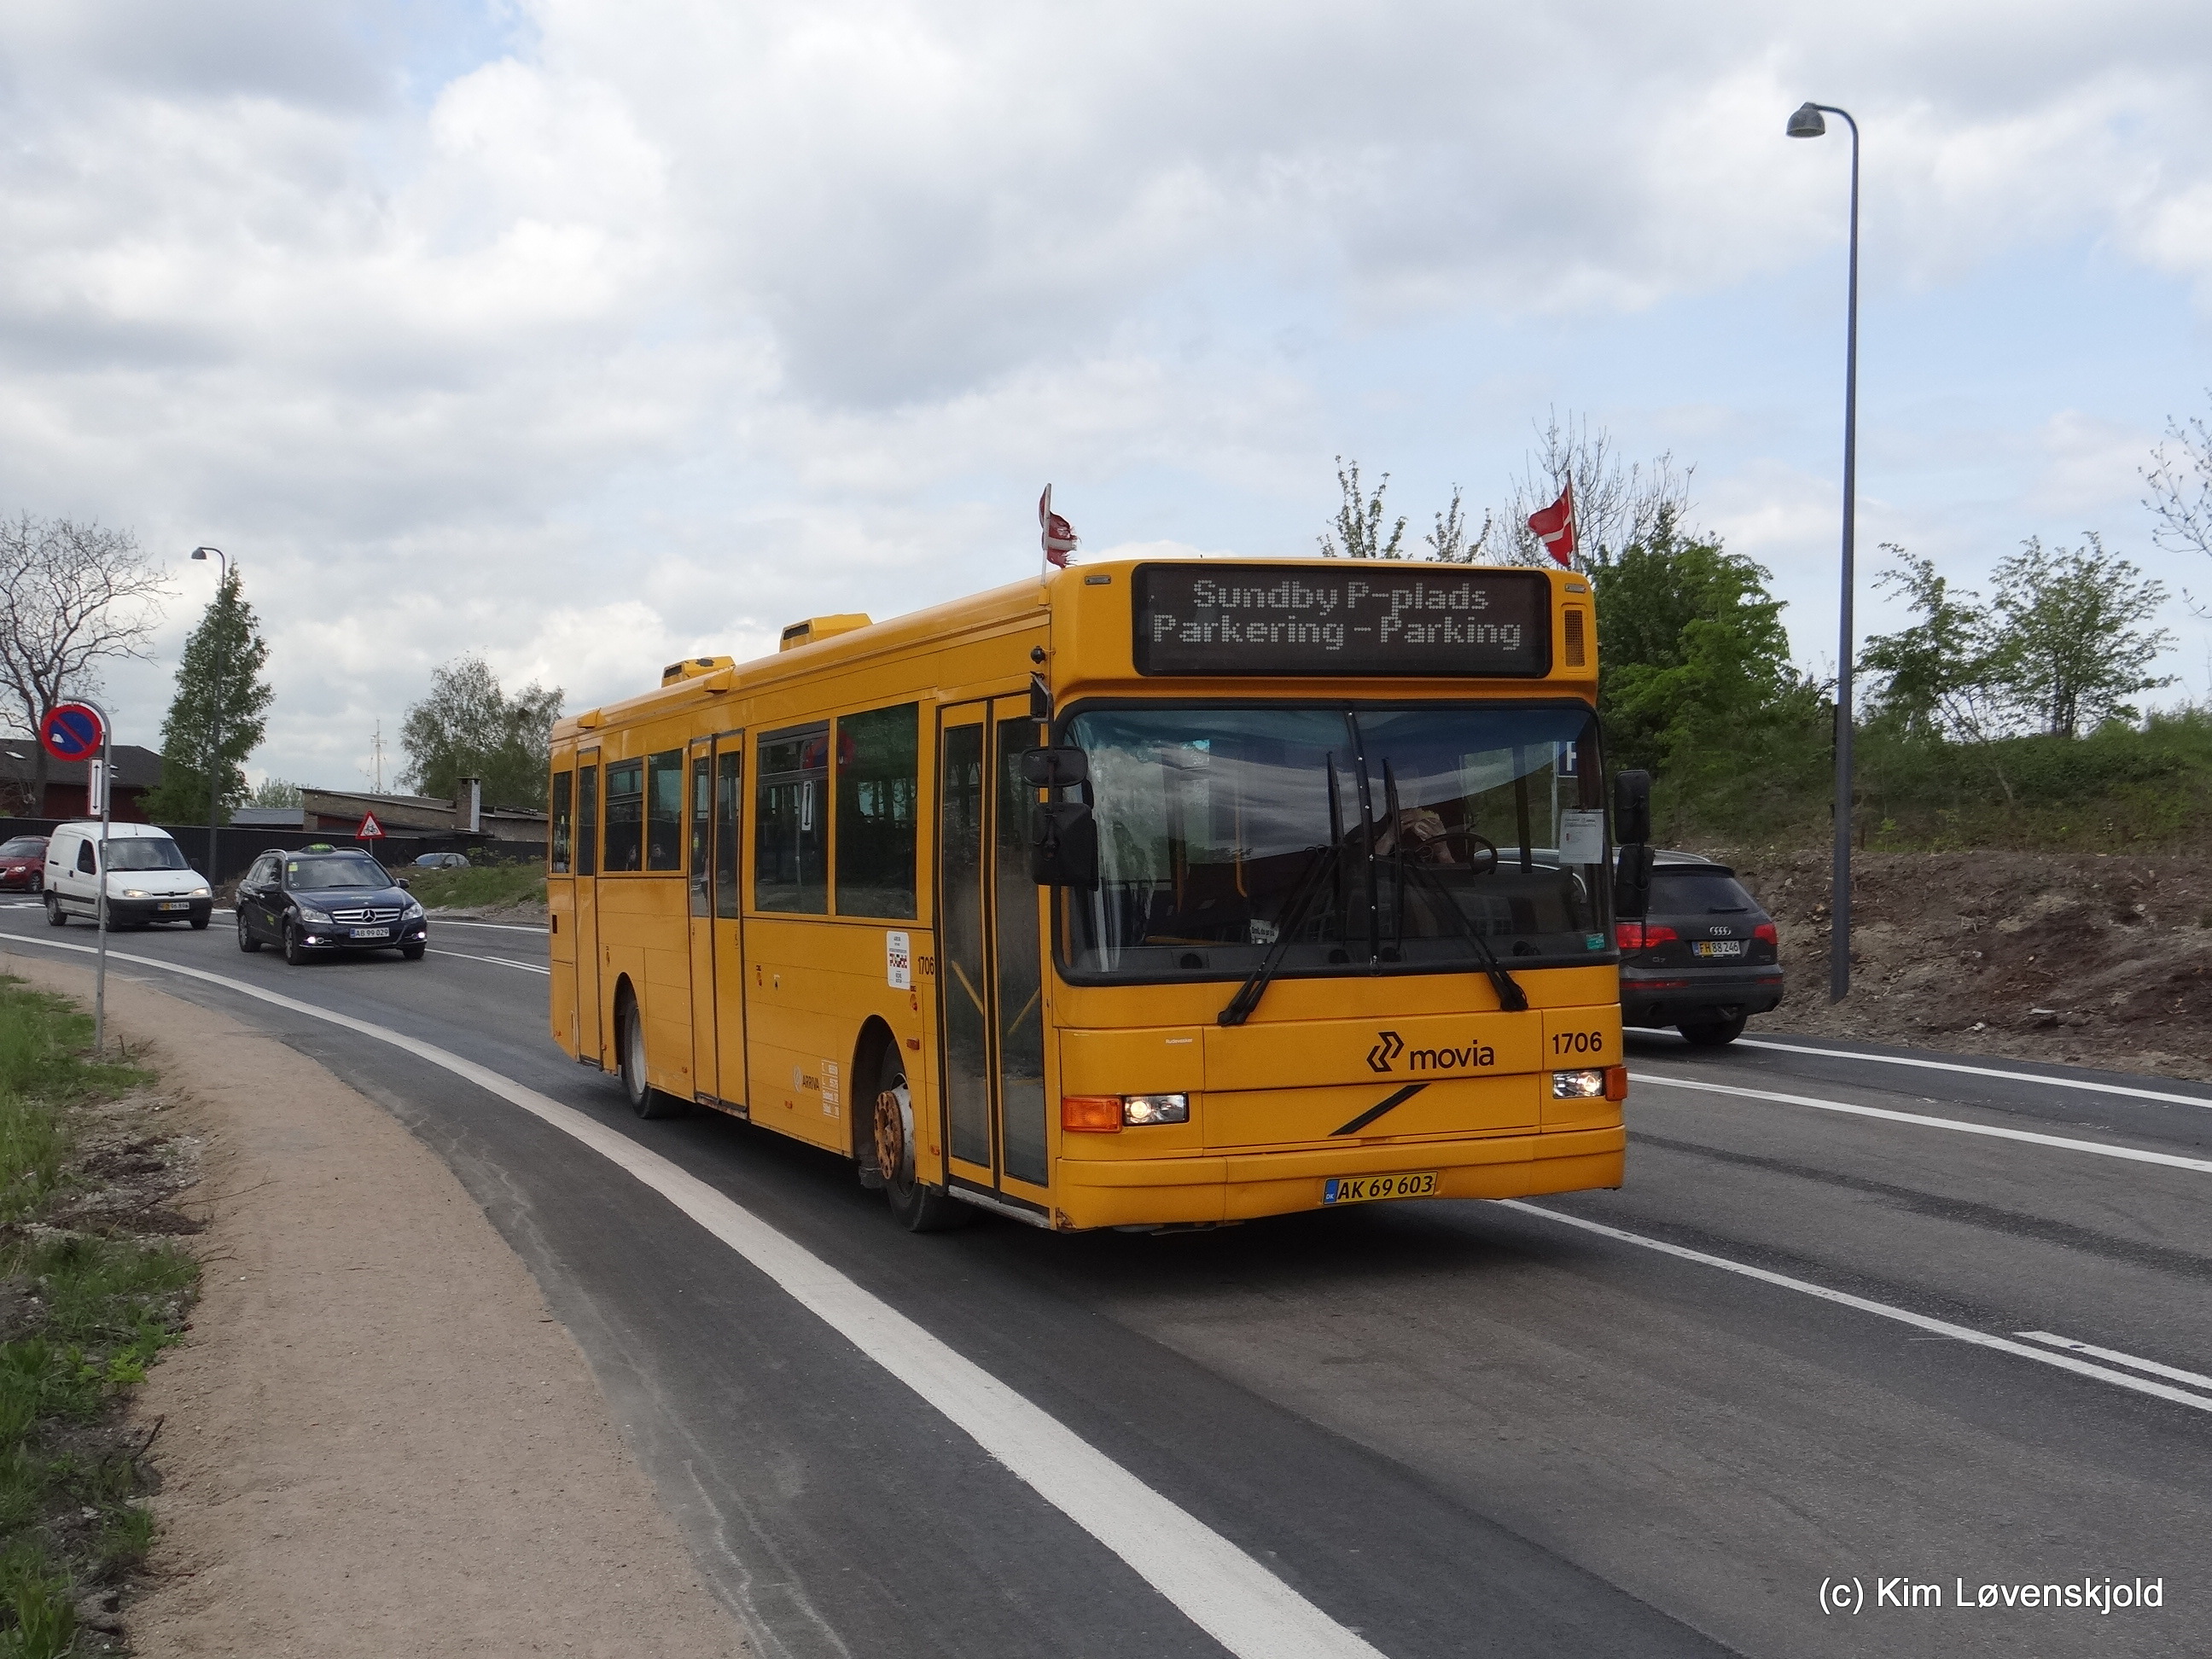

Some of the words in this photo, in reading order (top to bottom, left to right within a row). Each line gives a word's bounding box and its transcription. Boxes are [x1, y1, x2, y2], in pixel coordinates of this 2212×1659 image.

[1193, 579, 1338, 616] Sundby
[1348, 581, 1489, 617] P-plads
[1153, 614, 1344, 651] Parkering
[1380, 615, 1522, 651] Parking
[376, 928, 388, 936] 029
[1699, 943, 1711, 952] FH
[1712, 942, 1723, 952] 88
[1724, 941, 1738, 952] 246
[917, 956, 934, 975] 1706
[1410, 1039, 1494, 1070] movia
[1552, 1031, 1603, 1055] 1706
[802, 1074, 820, 1091] ARRIVA
[1337, 1180, 1365, 1200] AK
[1369, 1179, 1393, 1196] 69
[1397, 1175, 1434, 1195] 603
